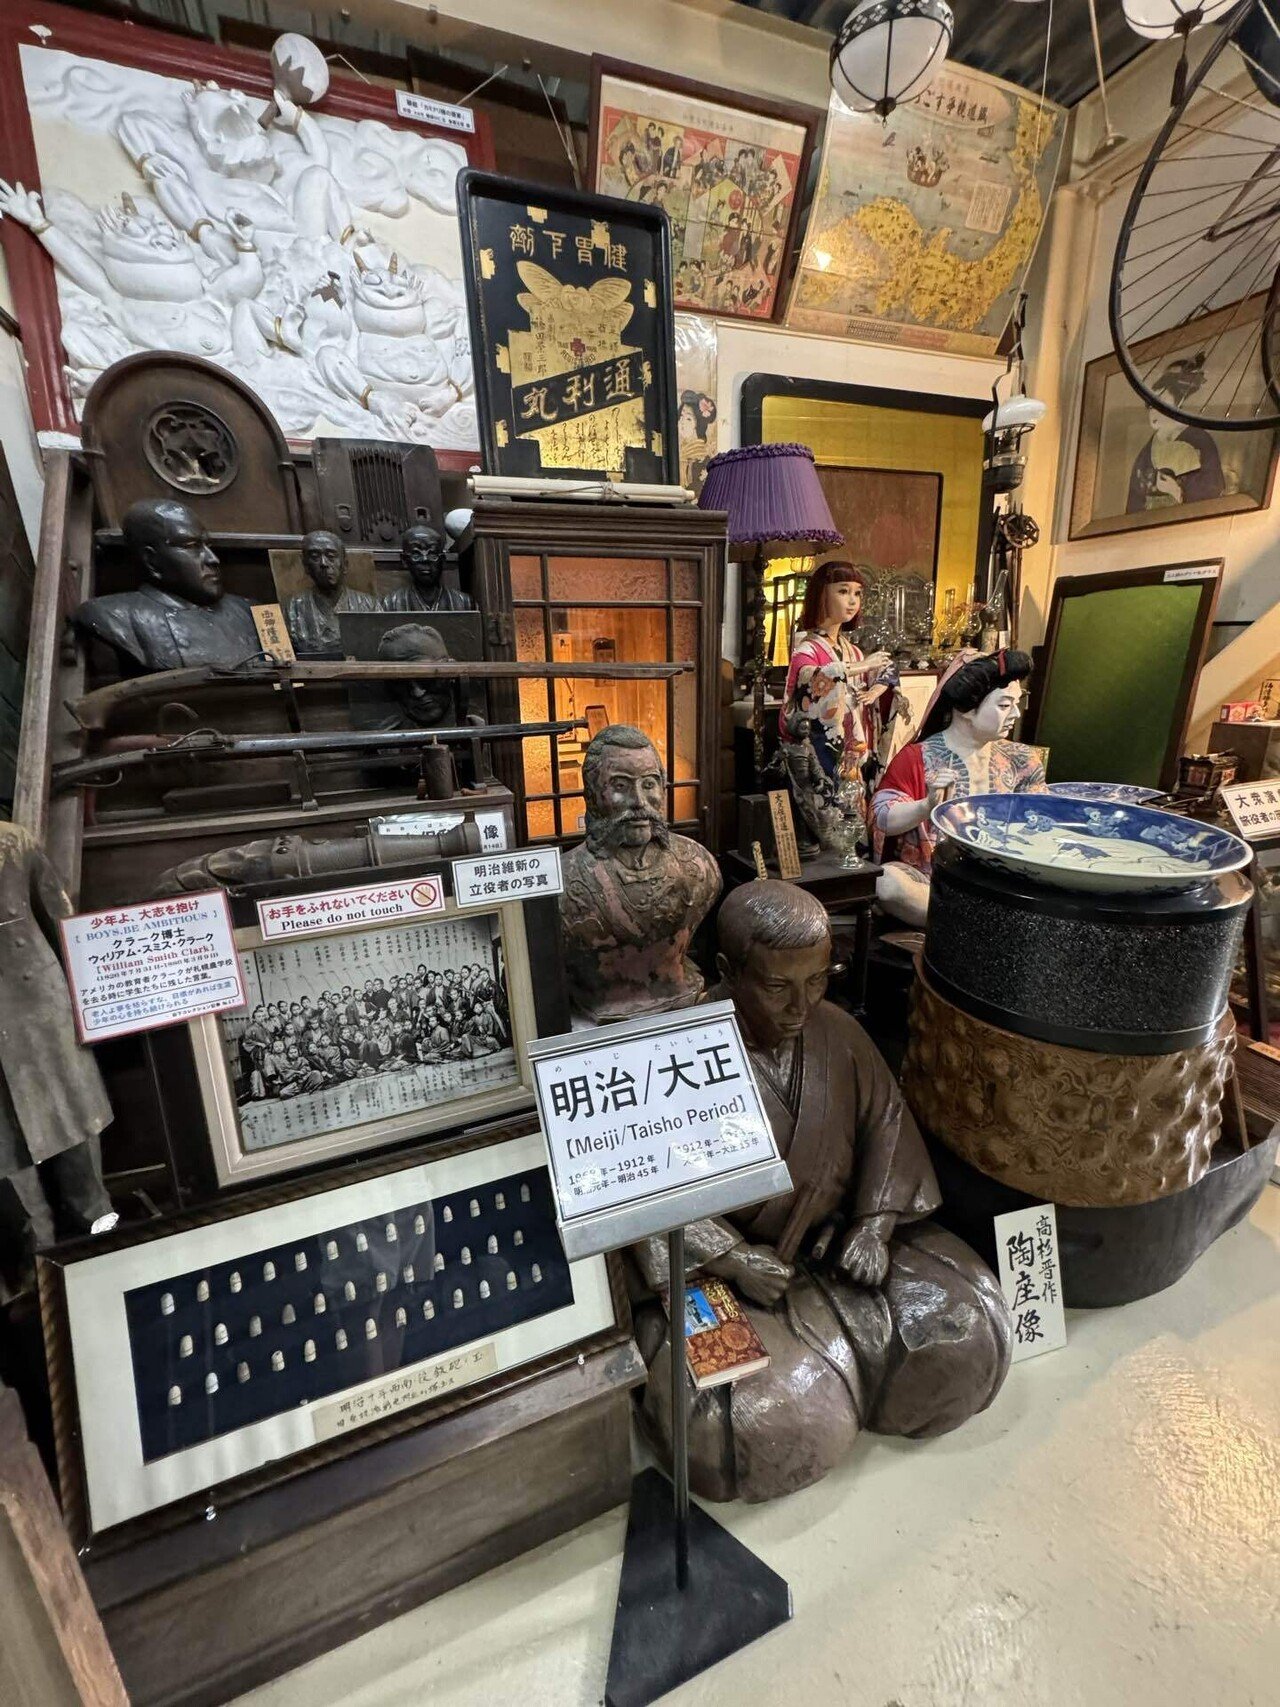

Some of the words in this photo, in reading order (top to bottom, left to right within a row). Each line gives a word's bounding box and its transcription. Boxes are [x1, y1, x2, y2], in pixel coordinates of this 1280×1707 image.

[1235, 787, 1280, 809] 大衆演
[474, 858, 540, 877] 明治維新の
[469, 874, 548, 896] 立役者の写真
[91, 901, 200, 929] 少年よ、大志を抱け
[268, 888, 410, 920] お手をふれないでください
[143, 911, 208, 931] AMBITIOUS
[281, 918, 323, 931] Please
[327, 914, 342, 924] do
[346, 909, 367, 920] not
[370, 905, 403, 917] touch
[113, 928, 185, 949] クラーク博士
[147, 951, 178, 964] Smith
[1036, 1215, 1057, 1304] 高杉晋作
[1006, 1231, 1044, 1344] 陶座像
